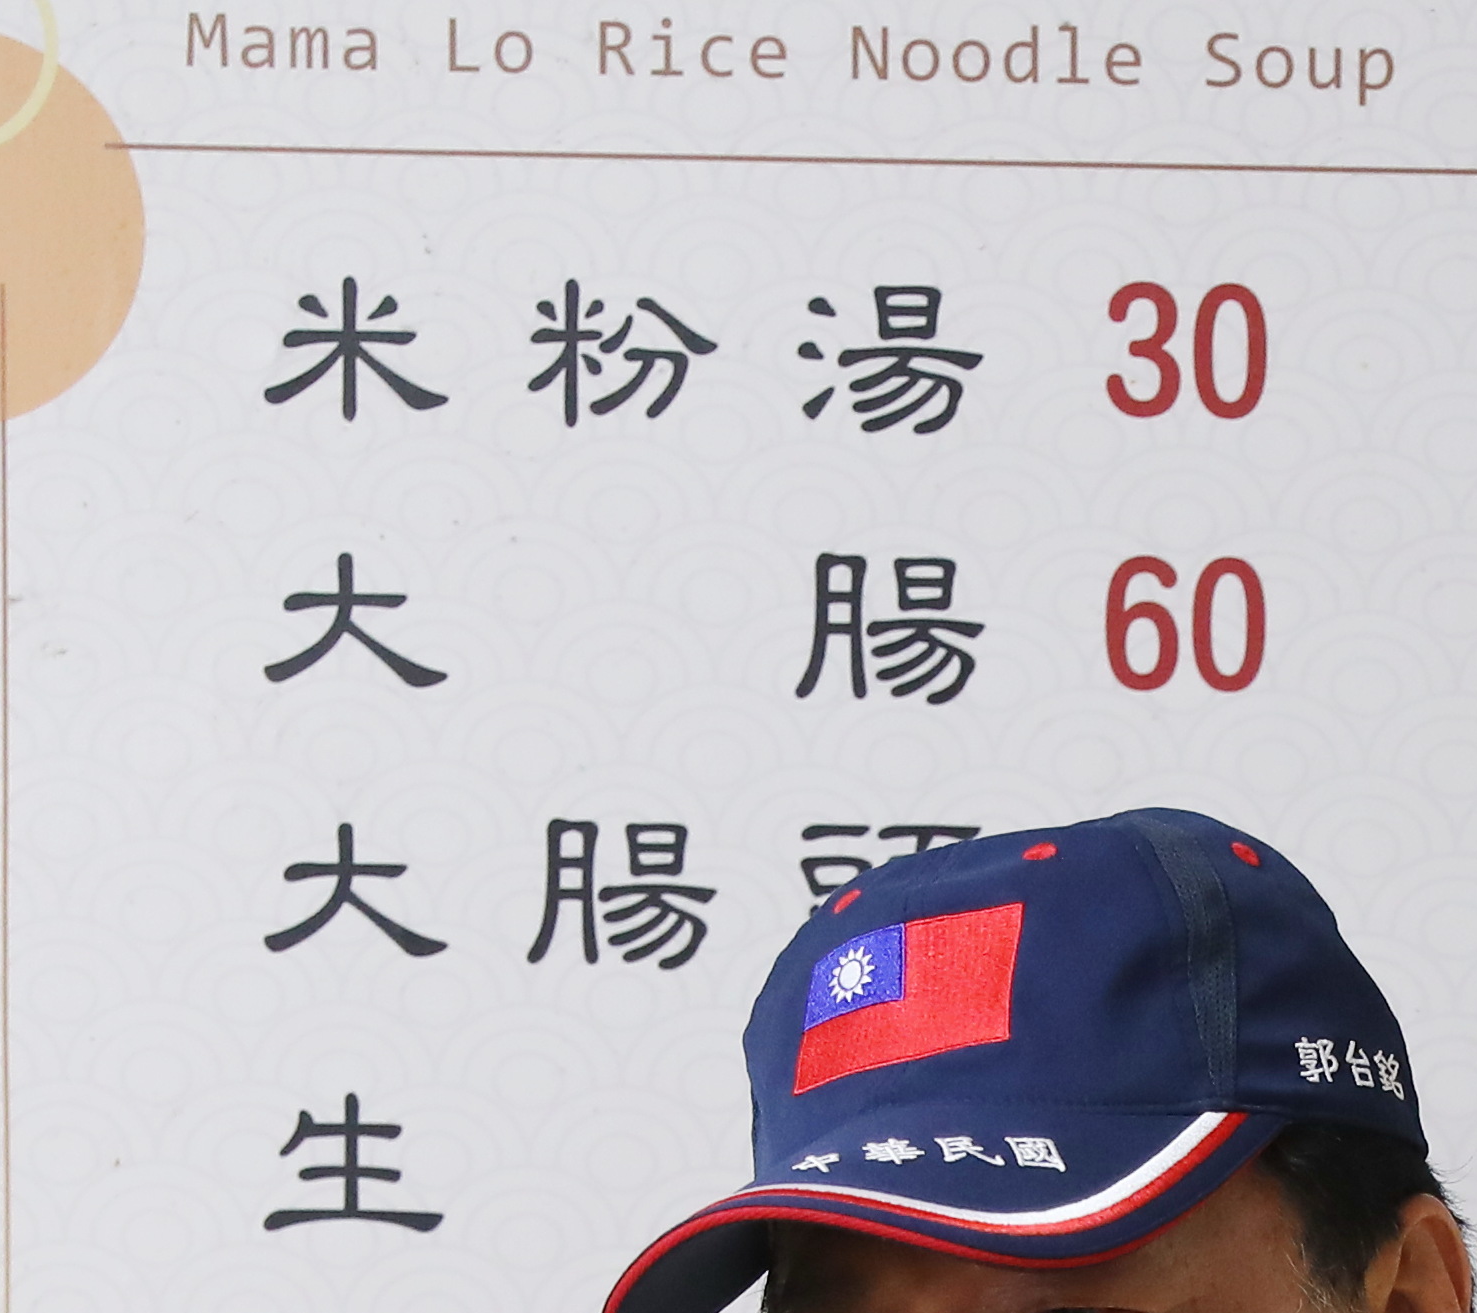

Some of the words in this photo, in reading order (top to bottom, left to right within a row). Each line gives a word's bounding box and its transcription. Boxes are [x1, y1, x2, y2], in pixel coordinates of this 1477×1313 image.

[186, 13, 379, 71] Mama
[447, 18, 533, 74] Lo
[597, 19, 788, 80] Rice
[850, 24, 1143, 86] Noodle
[1205, 32, 1397, 106] Soup
[264, 276, 984, 435] 米粉湯
[1106, 281, 1267, 420] 30
[1105, 555, 1267, 693] 60
[1293, 1036, 1405, 1100] 郭台銘
[263, 1092, 443, 1233] 生
[792, 1134, 1067, 1174] 中華民國
